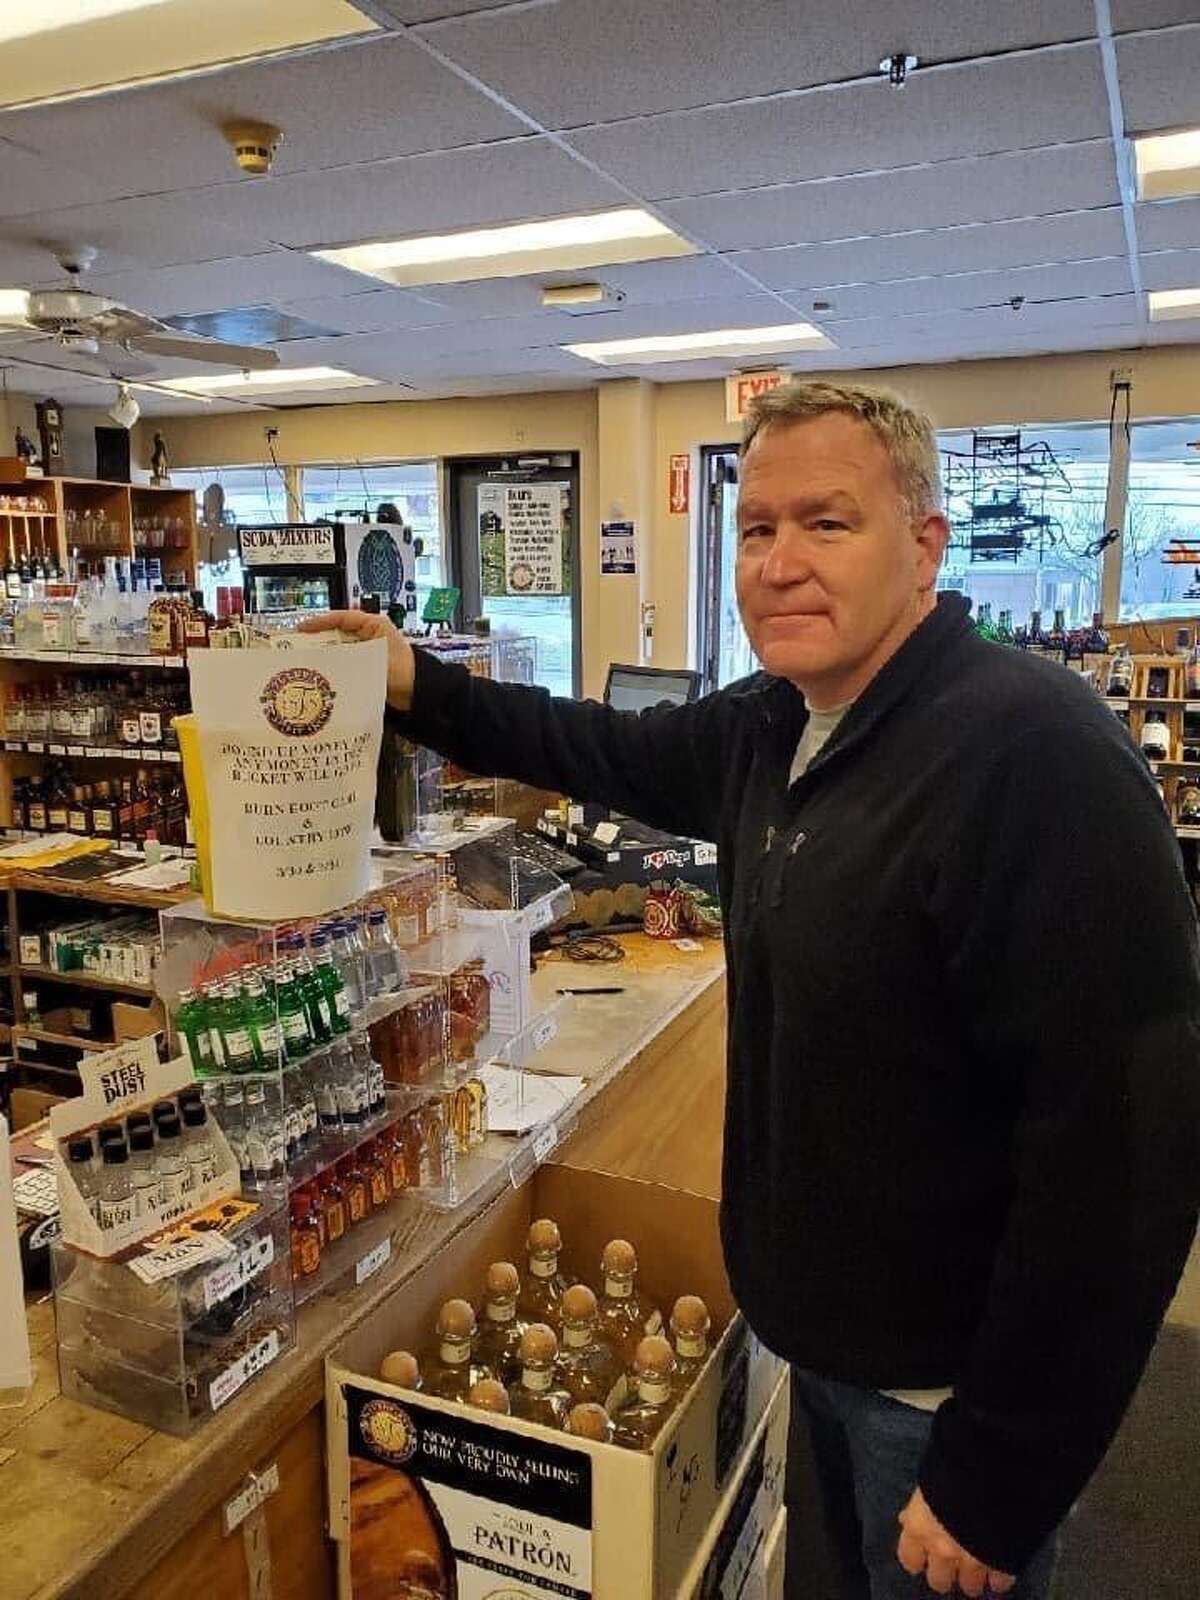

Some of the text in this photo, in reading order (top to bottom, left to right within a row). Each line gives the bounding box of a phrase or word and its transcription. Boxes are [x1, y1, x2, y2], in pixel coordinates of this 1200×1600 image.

[232, 769, 291, 785] BCKET
[267, 756, 320, 772] MONEY
[101, 1062, 145, 1088] STEEL
[104, 1075, 146, 1103] DUST
[423, 1429, 456, 1450] NOW
[461, 1440, 520, 1467] PROUDLY
[526, 1457, 580, 1485] SELLING
[423, 1442, 531, 1484] OUR VERY OWN
[475, 1525, 572, 1574] PATRÓN
